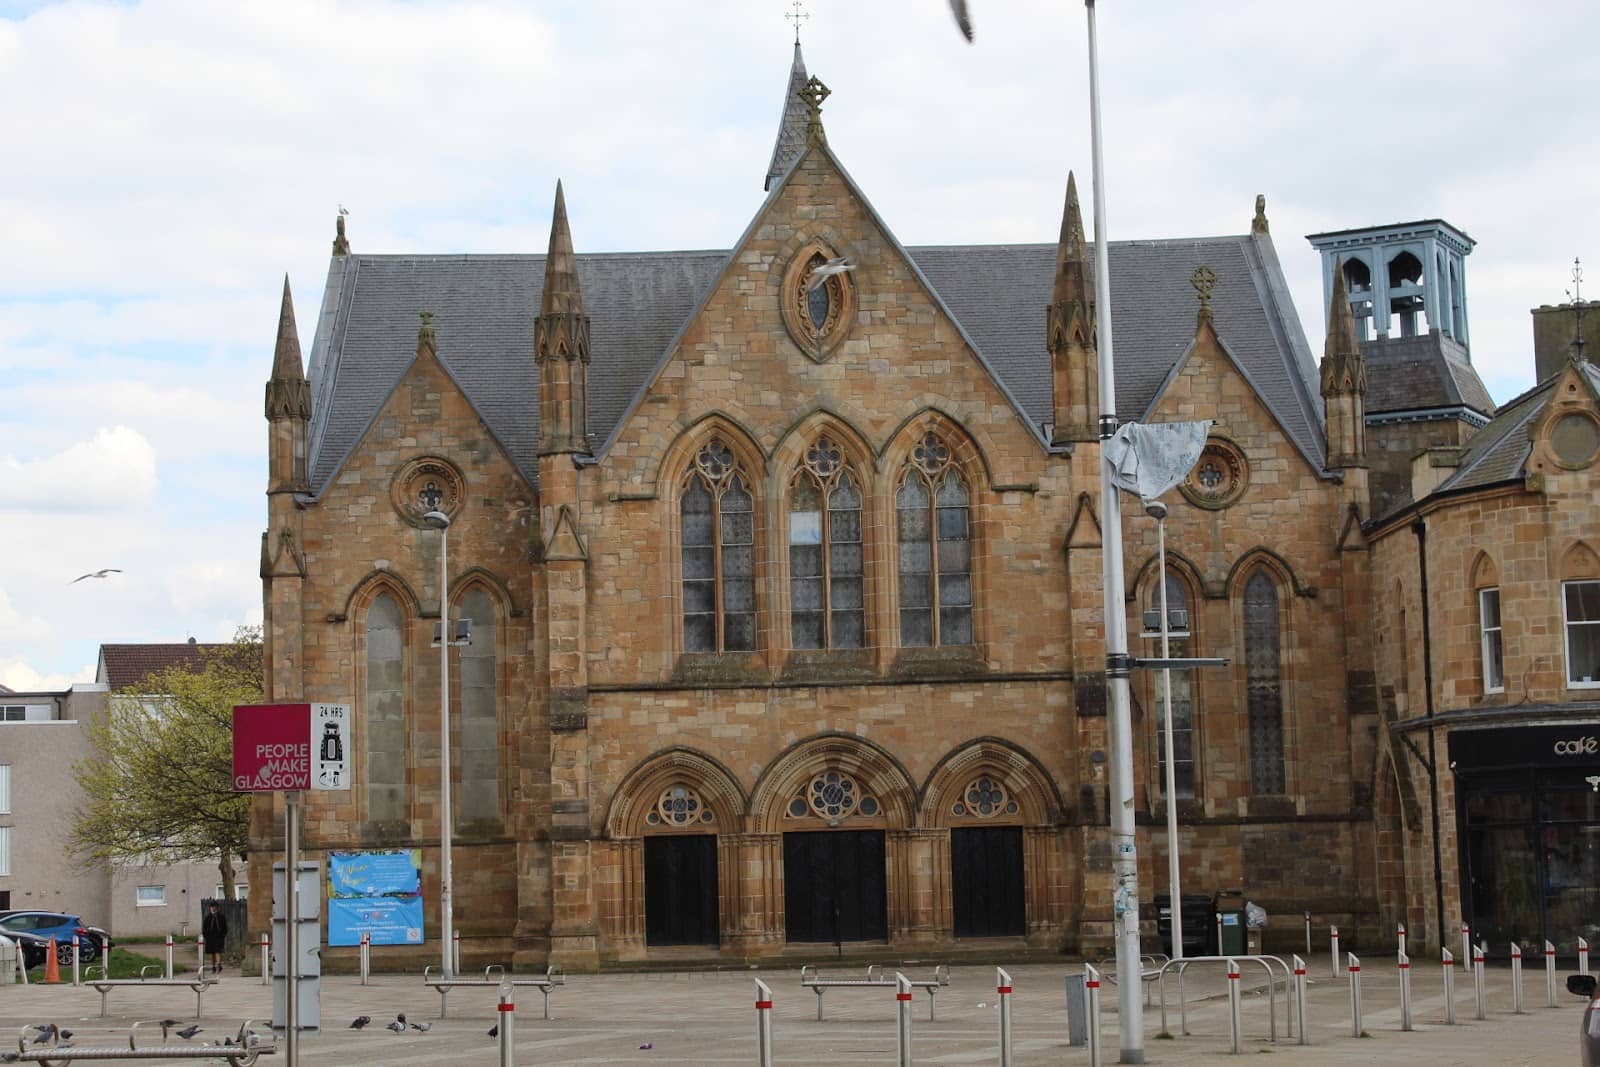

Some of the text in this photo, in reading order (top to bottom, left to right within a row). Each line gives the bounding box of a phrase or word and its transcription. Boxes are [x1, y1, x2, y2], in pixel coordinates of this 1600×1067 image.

[320, 706, 343, 718] 24 HRS
[256, 744, 308, 758] PEOPLE
[1554, 736, 1598, 754] café
[268, 758, 308, 773] MAKE
[235, 774, 308, 789] GLASGOW
